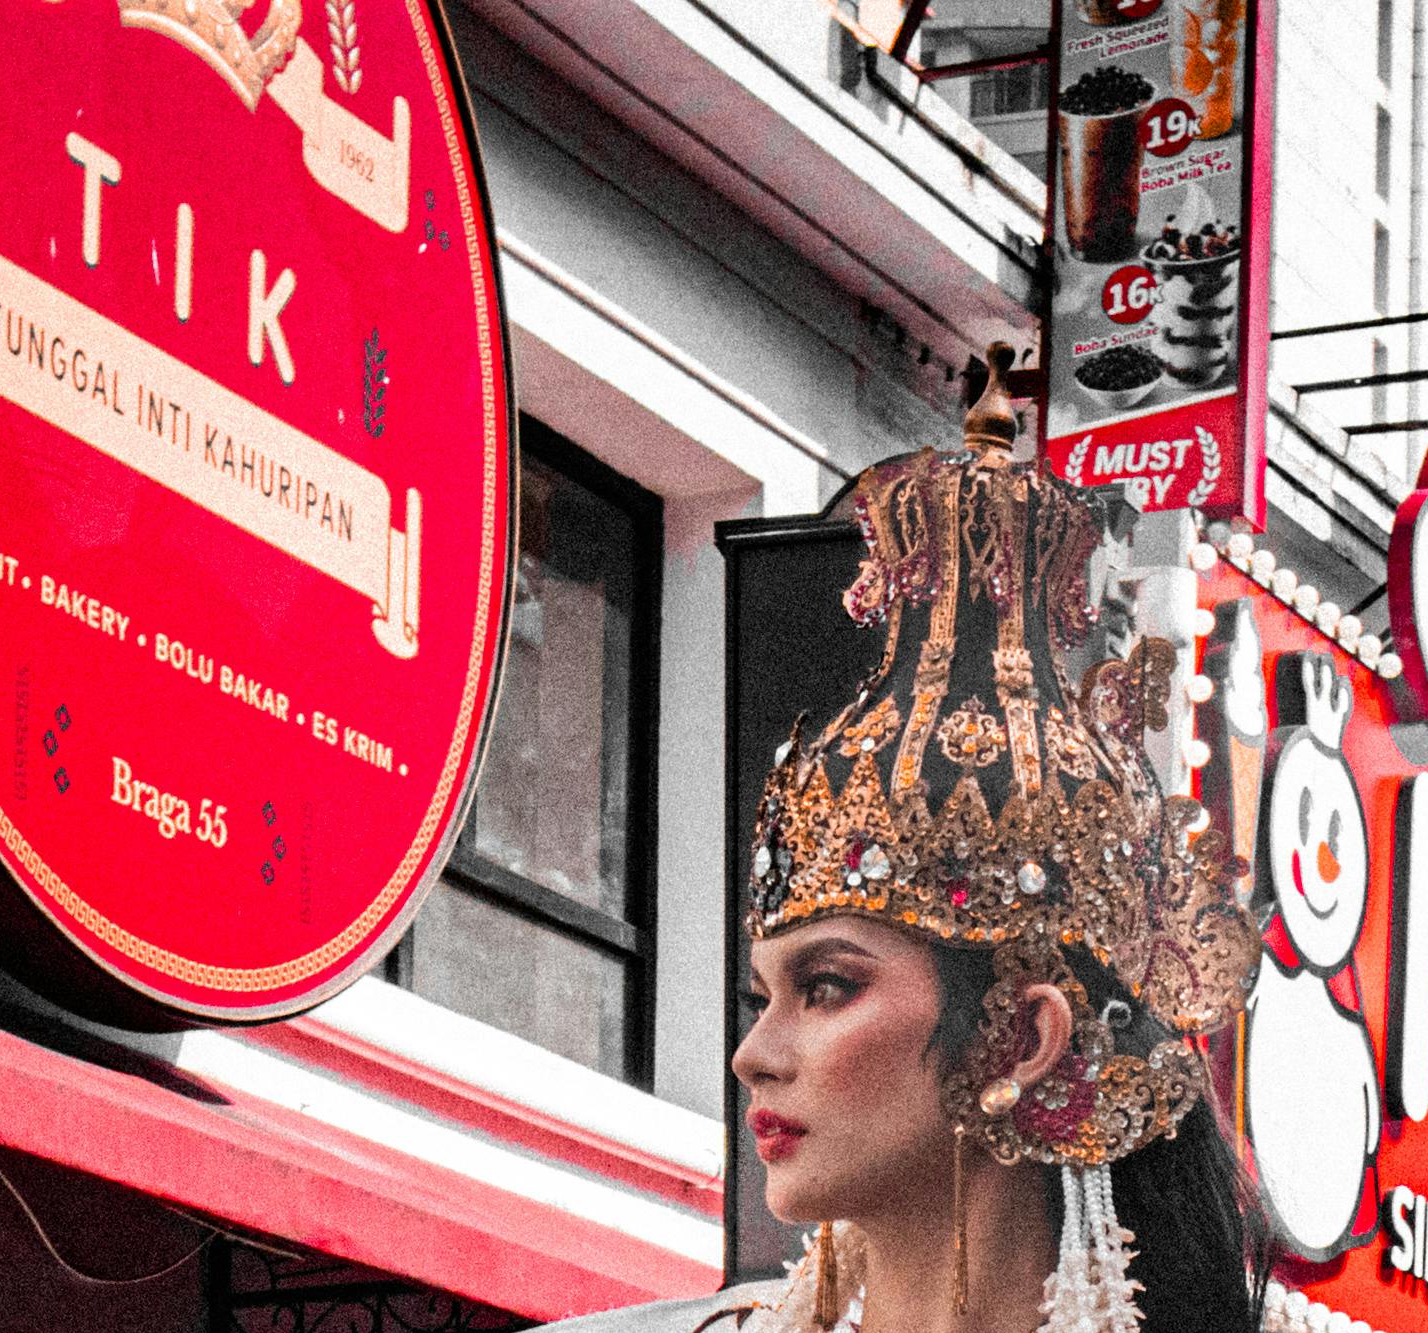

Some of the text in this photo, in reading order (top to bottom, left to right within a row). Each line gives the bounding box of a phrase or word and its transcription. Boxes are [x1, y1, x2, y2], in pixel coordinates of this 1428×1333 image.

[1099, 31, 1169, 59] Lemonade
[339, 139, 375, 182] 1962
[1140, 149, 1226, 181] Brown Sugar
[1140, 160, 1233, 193] Boba Milk Tea
[65, 131, 297, 386] TIK
[1074, 325, 1160, 355] Boba Sundae
[137, 384, 191, 452] INTI
[204, 423, 354, 542] KAHURIPAN
[1092, 439, 1194, 476] MUST
[1111, 473, 1176, 508] RY
[40, 574, 130, 641] BAKERY
[154, 633, 214, 684] BOLU
[219, 665, 290, 722] BAKAR
[311, 711, 339, 746] ES
[343, 726, 394, 773] KRIM
[110, 755, 228, 848] Braga 55
